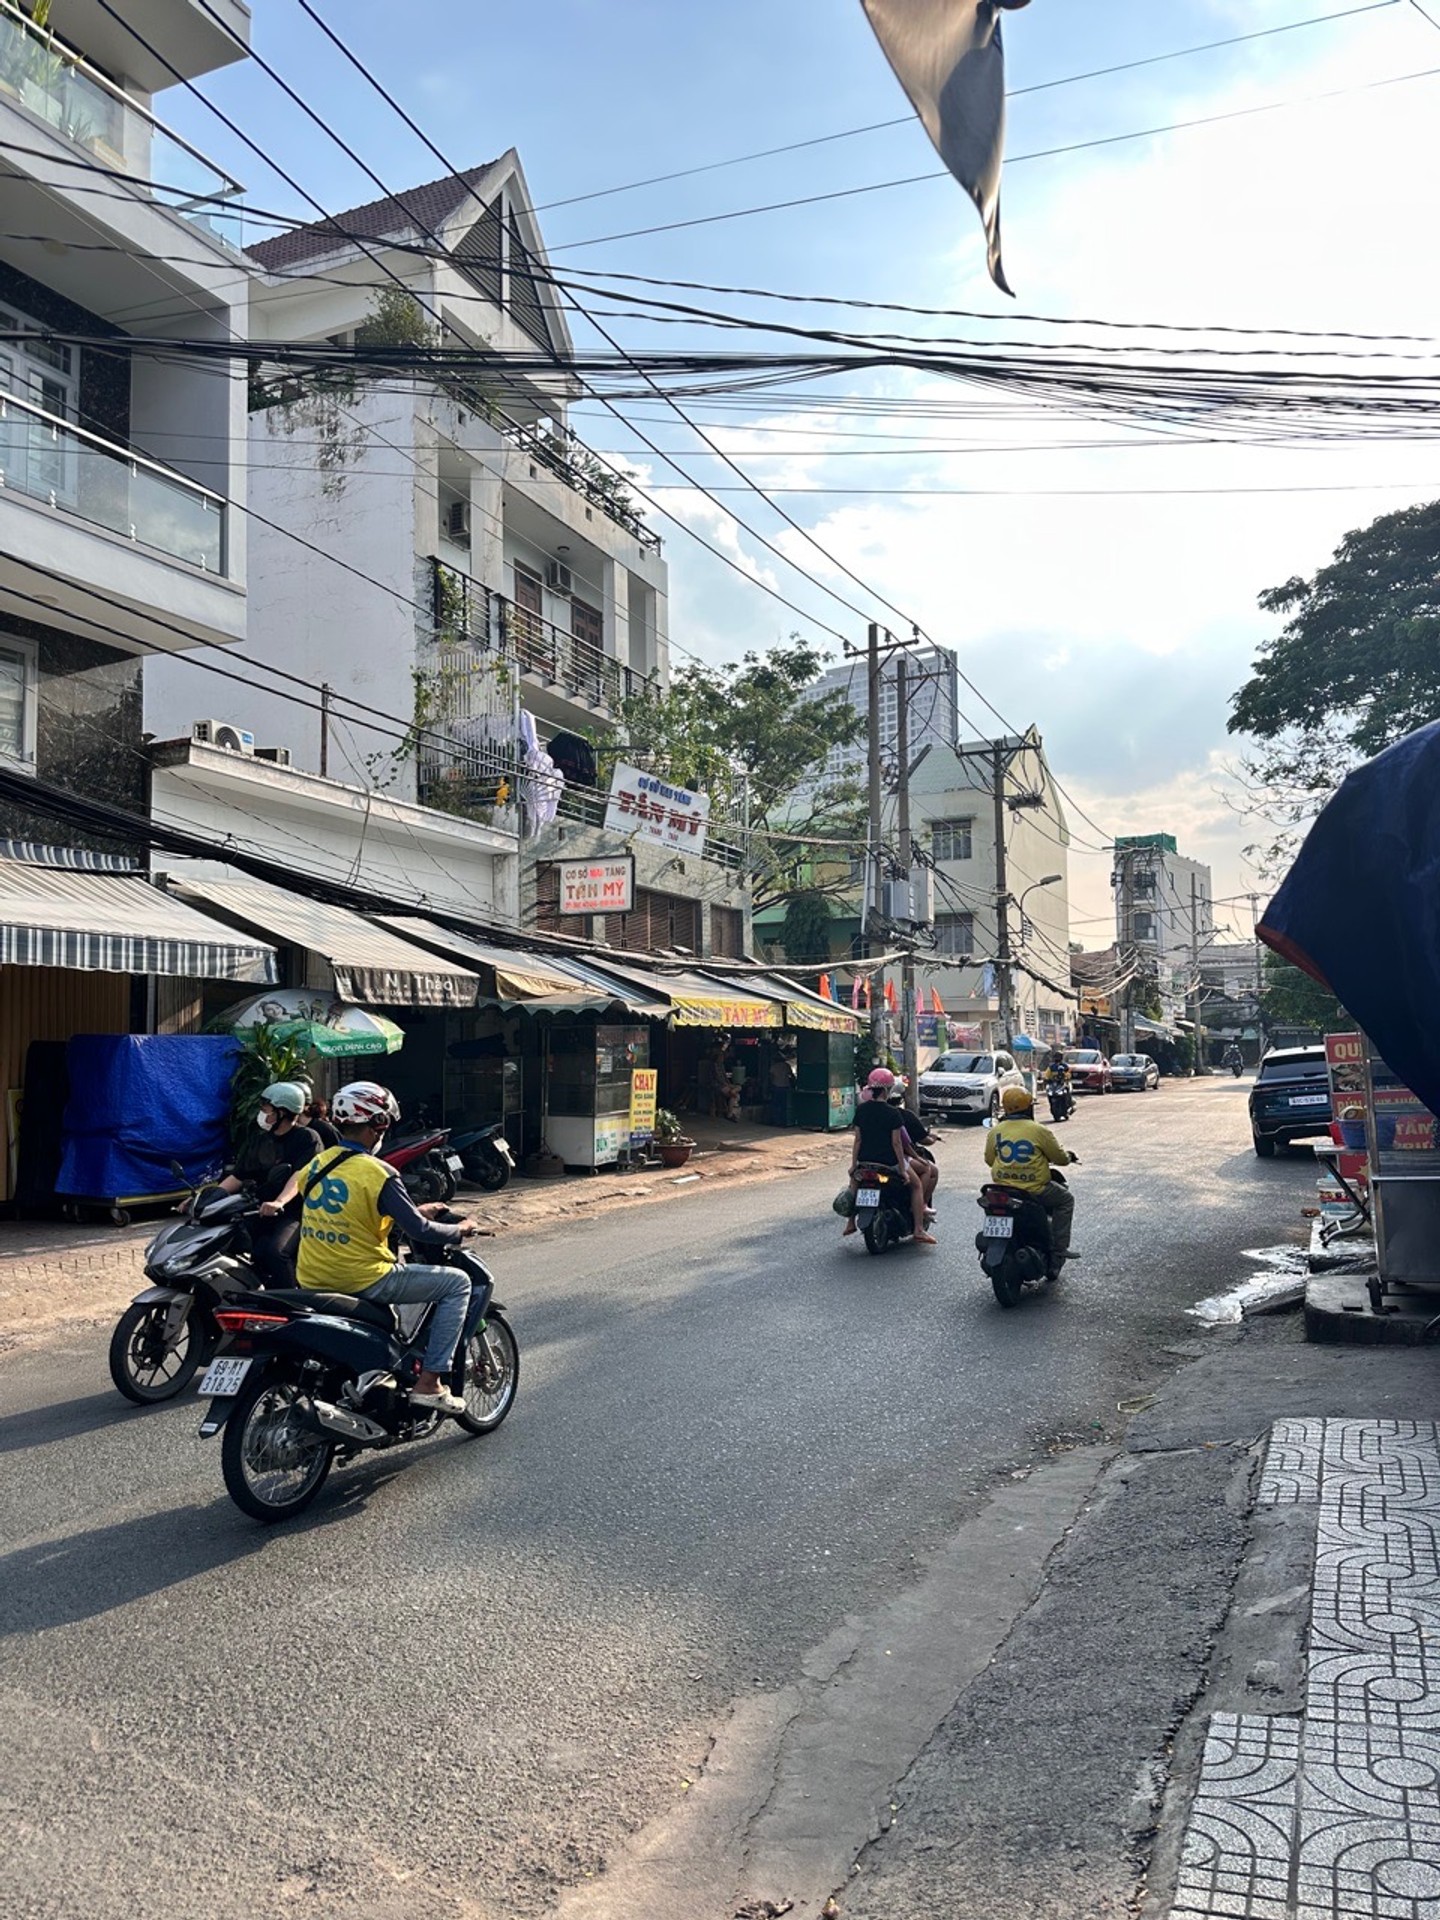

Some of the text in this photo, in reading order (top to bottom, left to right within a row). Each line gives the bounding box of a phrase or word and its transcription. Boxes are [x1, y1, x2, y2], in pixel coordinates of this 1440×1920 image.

[414, 974, 453, 991] Thảo
[996, 1133, 1035, 1164] be
[305, 1159, 349, 1214] be
